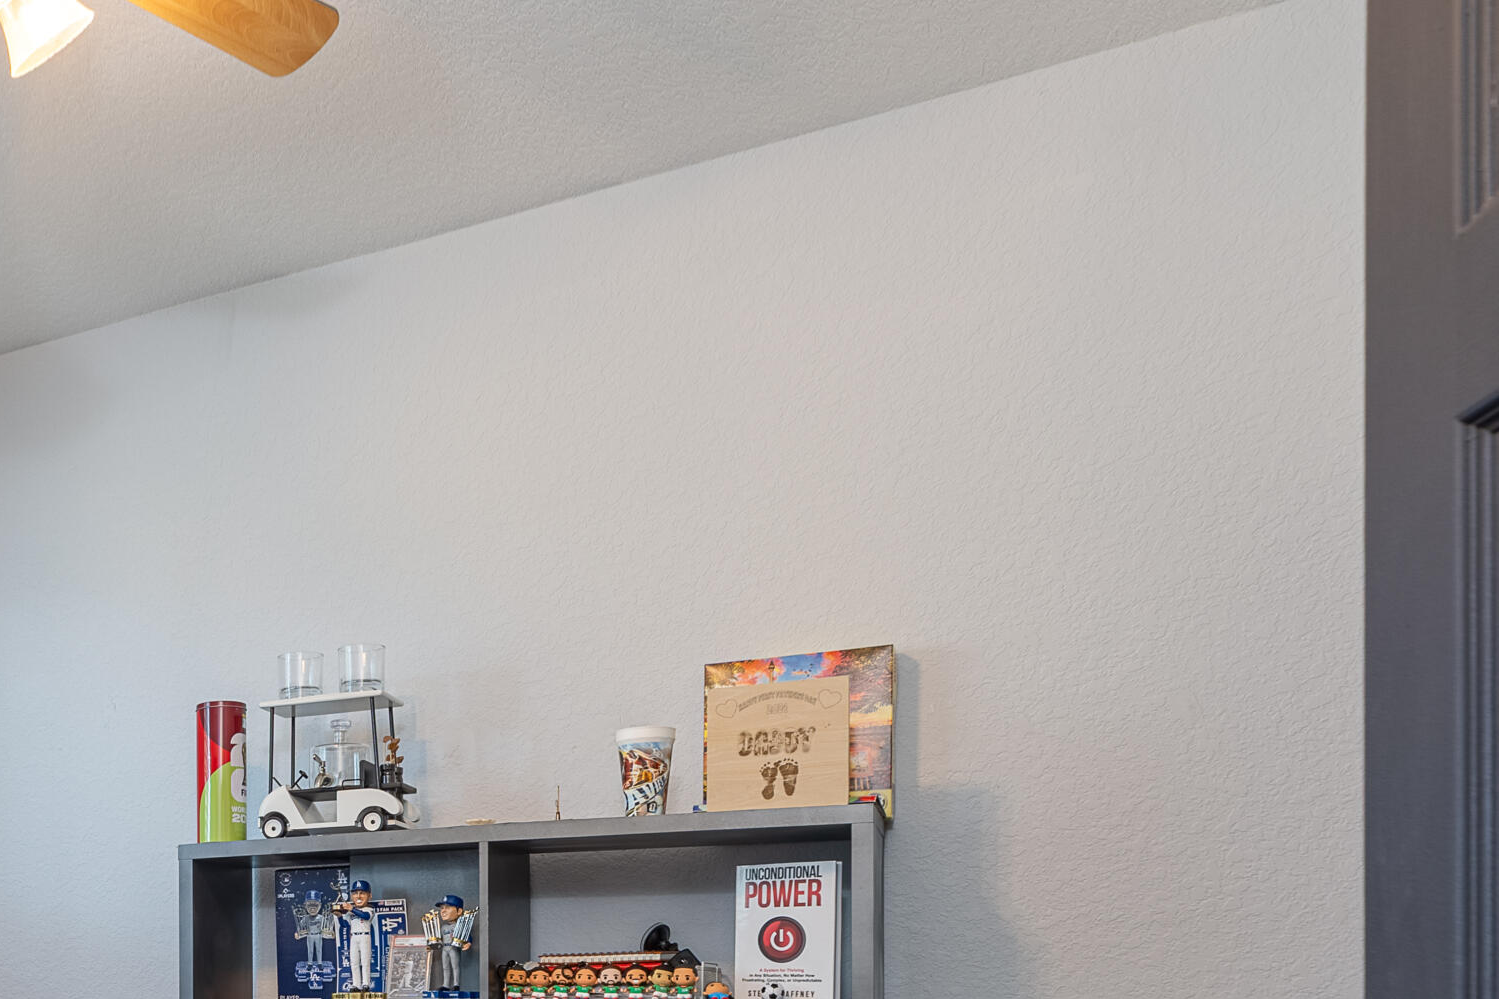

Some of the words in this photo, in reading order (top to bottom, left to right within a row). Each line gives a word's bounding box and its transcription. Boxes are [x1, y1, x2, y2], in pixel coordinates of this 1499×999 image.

[231, 814, 246, 823] 20
[745, 865, 822, 880] UNCONDITIONAL
[744, 879, 822, 908] POWER
[786, 990, 815, 998] AFFNEY
